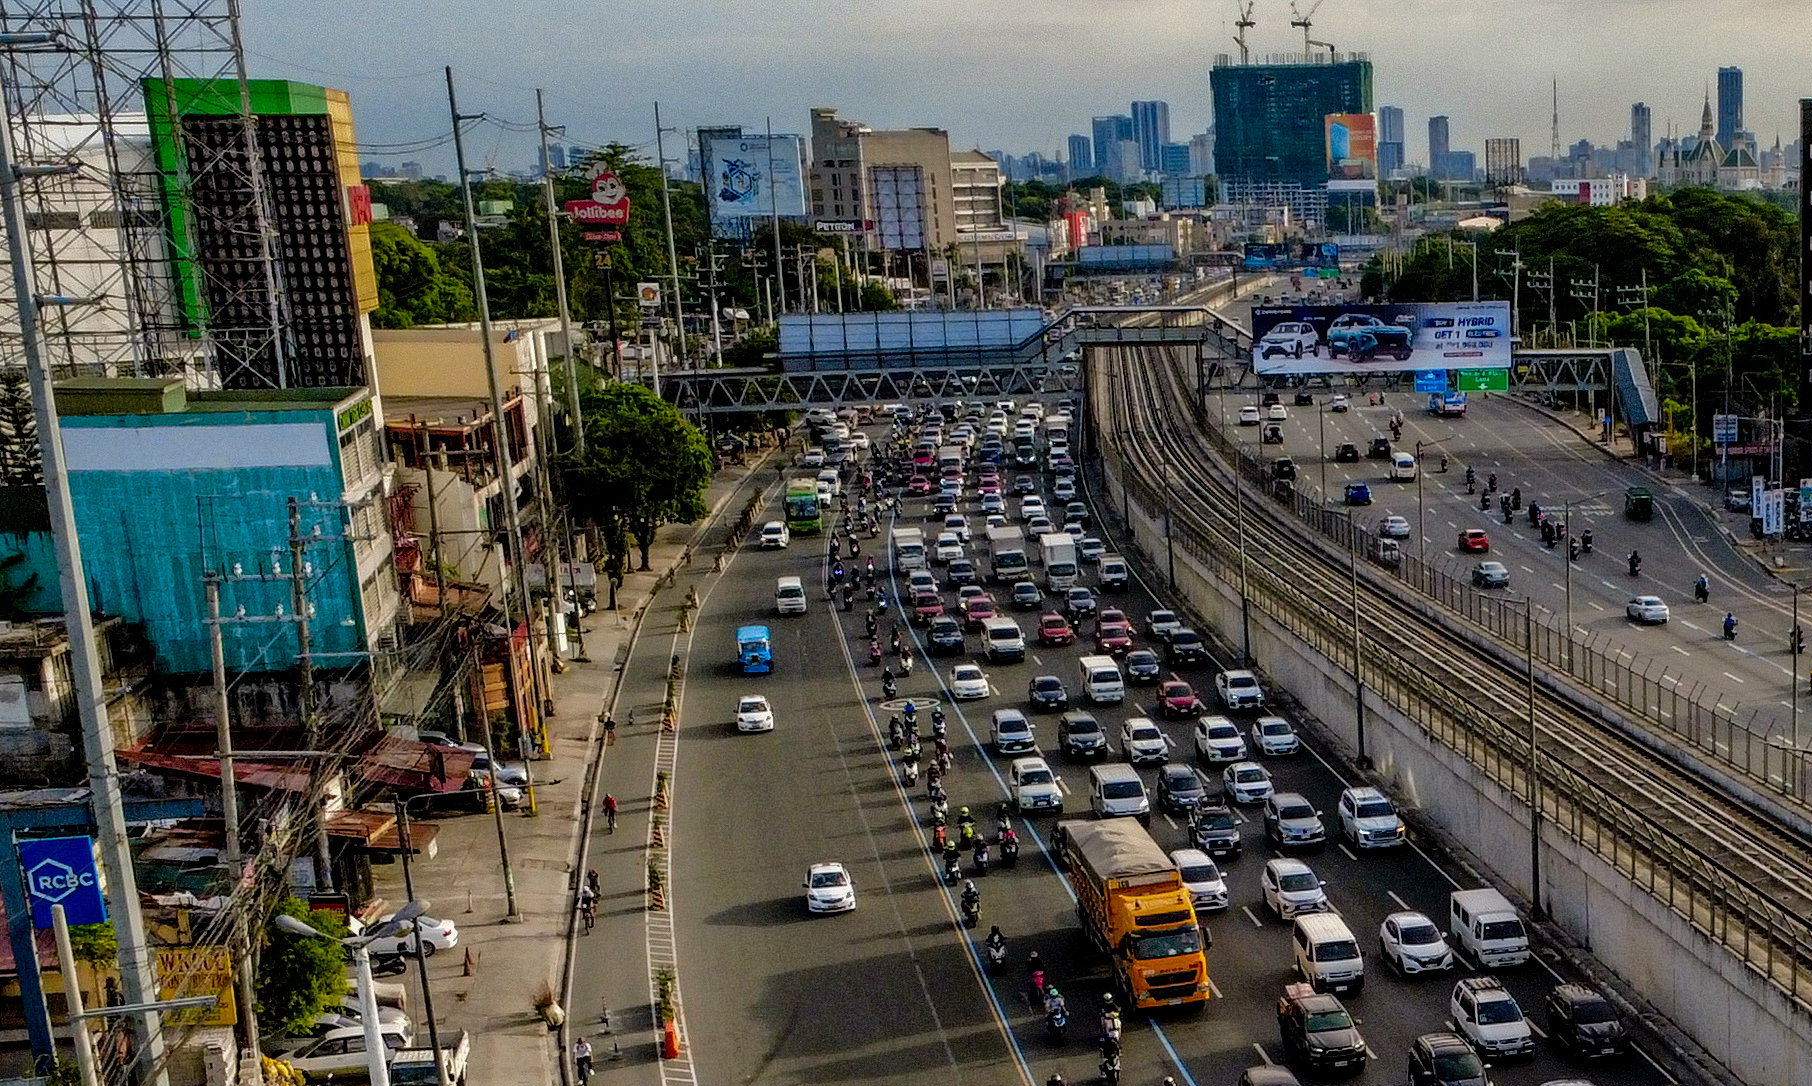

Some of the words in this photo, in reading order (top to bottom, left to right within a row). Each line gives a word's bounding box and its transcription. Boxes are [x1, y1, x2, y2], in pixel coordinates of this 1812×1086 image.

[574, 206, 625, 219] Jollibee
[816, 221, 855, 231] PETRON
[594, 254, 612, 267] 24
[1457, 316, 1495, 327] HYBRID
[39, 872, 94, 890] RCBC
